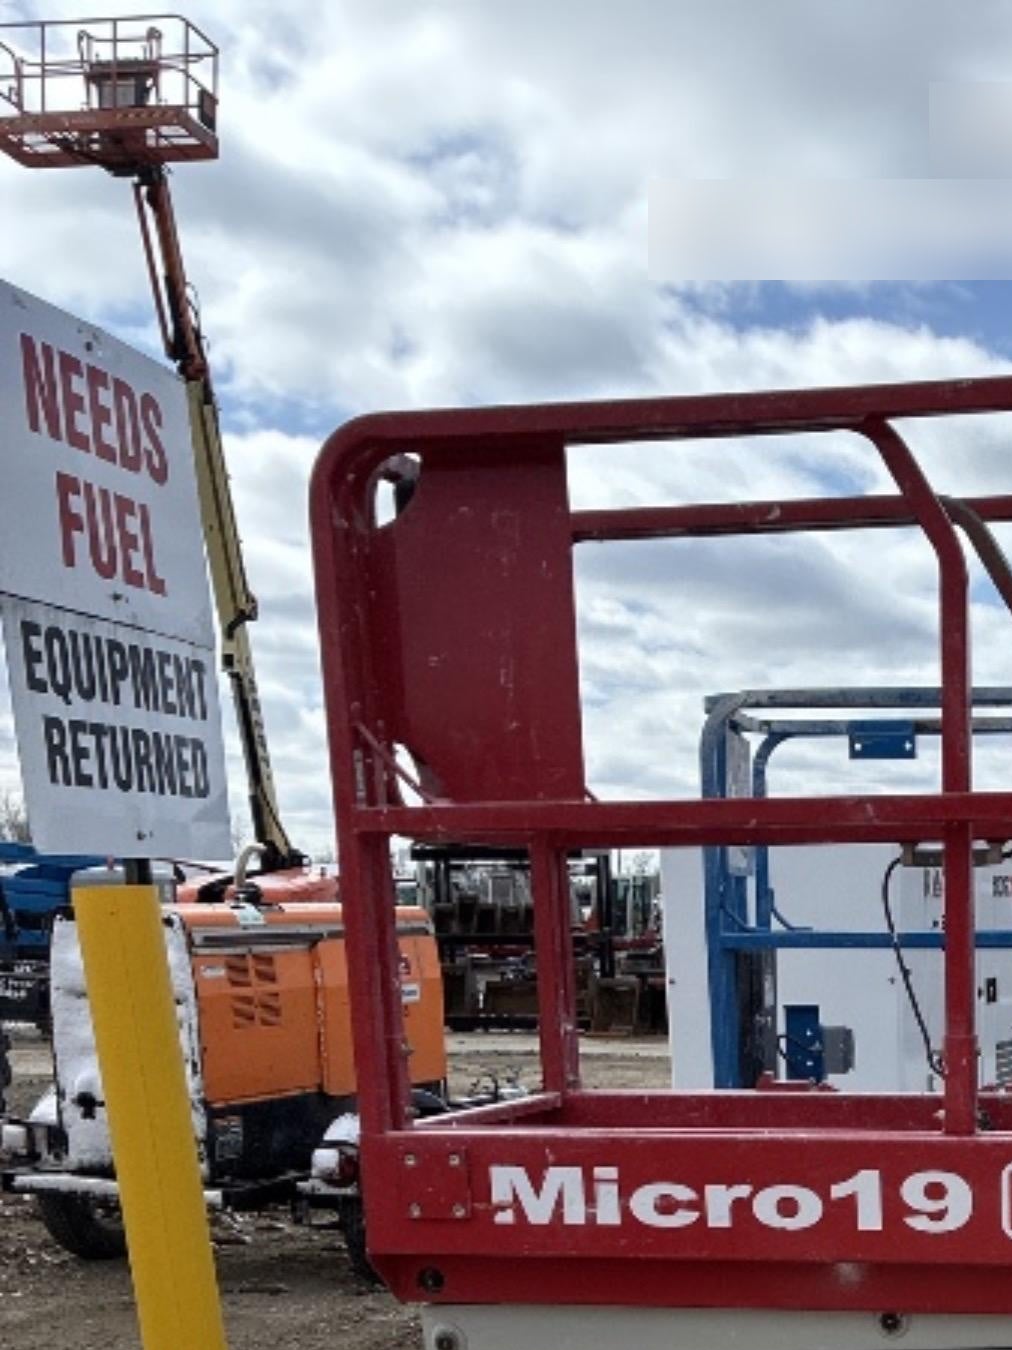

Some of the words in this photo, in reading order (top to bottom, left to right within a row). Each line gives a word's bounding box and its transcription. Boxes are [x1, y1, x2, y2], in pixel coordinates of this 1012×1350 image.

[20, 333, 168, 486] NEEDS
[55, 470, 167, 598] FUEL
[20, 619, 209, 721] EQUIPMENT
[42, 713, 211, 799] RETURNED
[488, 1165, 973, 1233] Micro19
